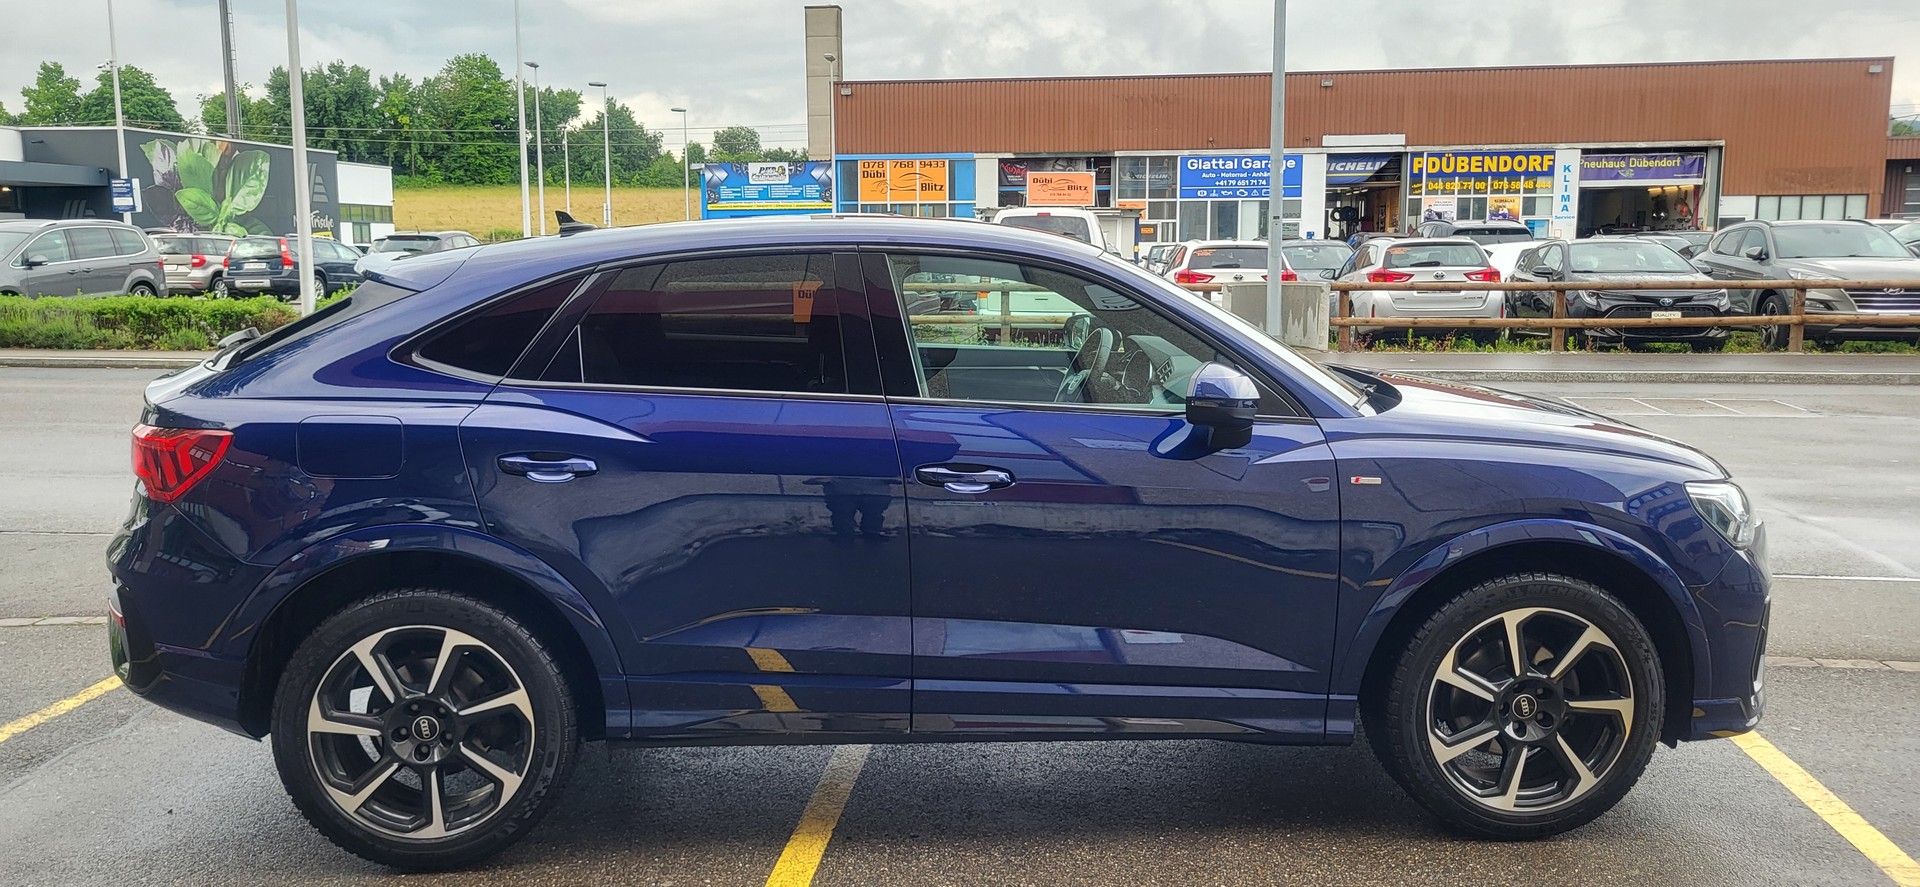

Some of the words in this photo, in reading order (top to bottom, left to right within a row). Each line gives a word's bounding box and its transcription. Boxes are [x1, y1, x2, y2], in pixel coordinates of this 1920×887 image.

[862, 161, 885, 169] 078
[893, 160, 914, 169] 768
[919, 160, 946, 169] 9433
[1187, 158, 1238, 170] Glattal
[1326, 161, 1388, 171] ICHELI
[1427, 153, 1555, 173] DÜBENDORF
[1629, 156, 1681, 168] Dübendorf
[862, 169, 886, 179] Dübi
[920, 182, 945, 192] Blitz
[1474, 181, 1486, 190] 00
[310, 210, 333, 230] Frische
